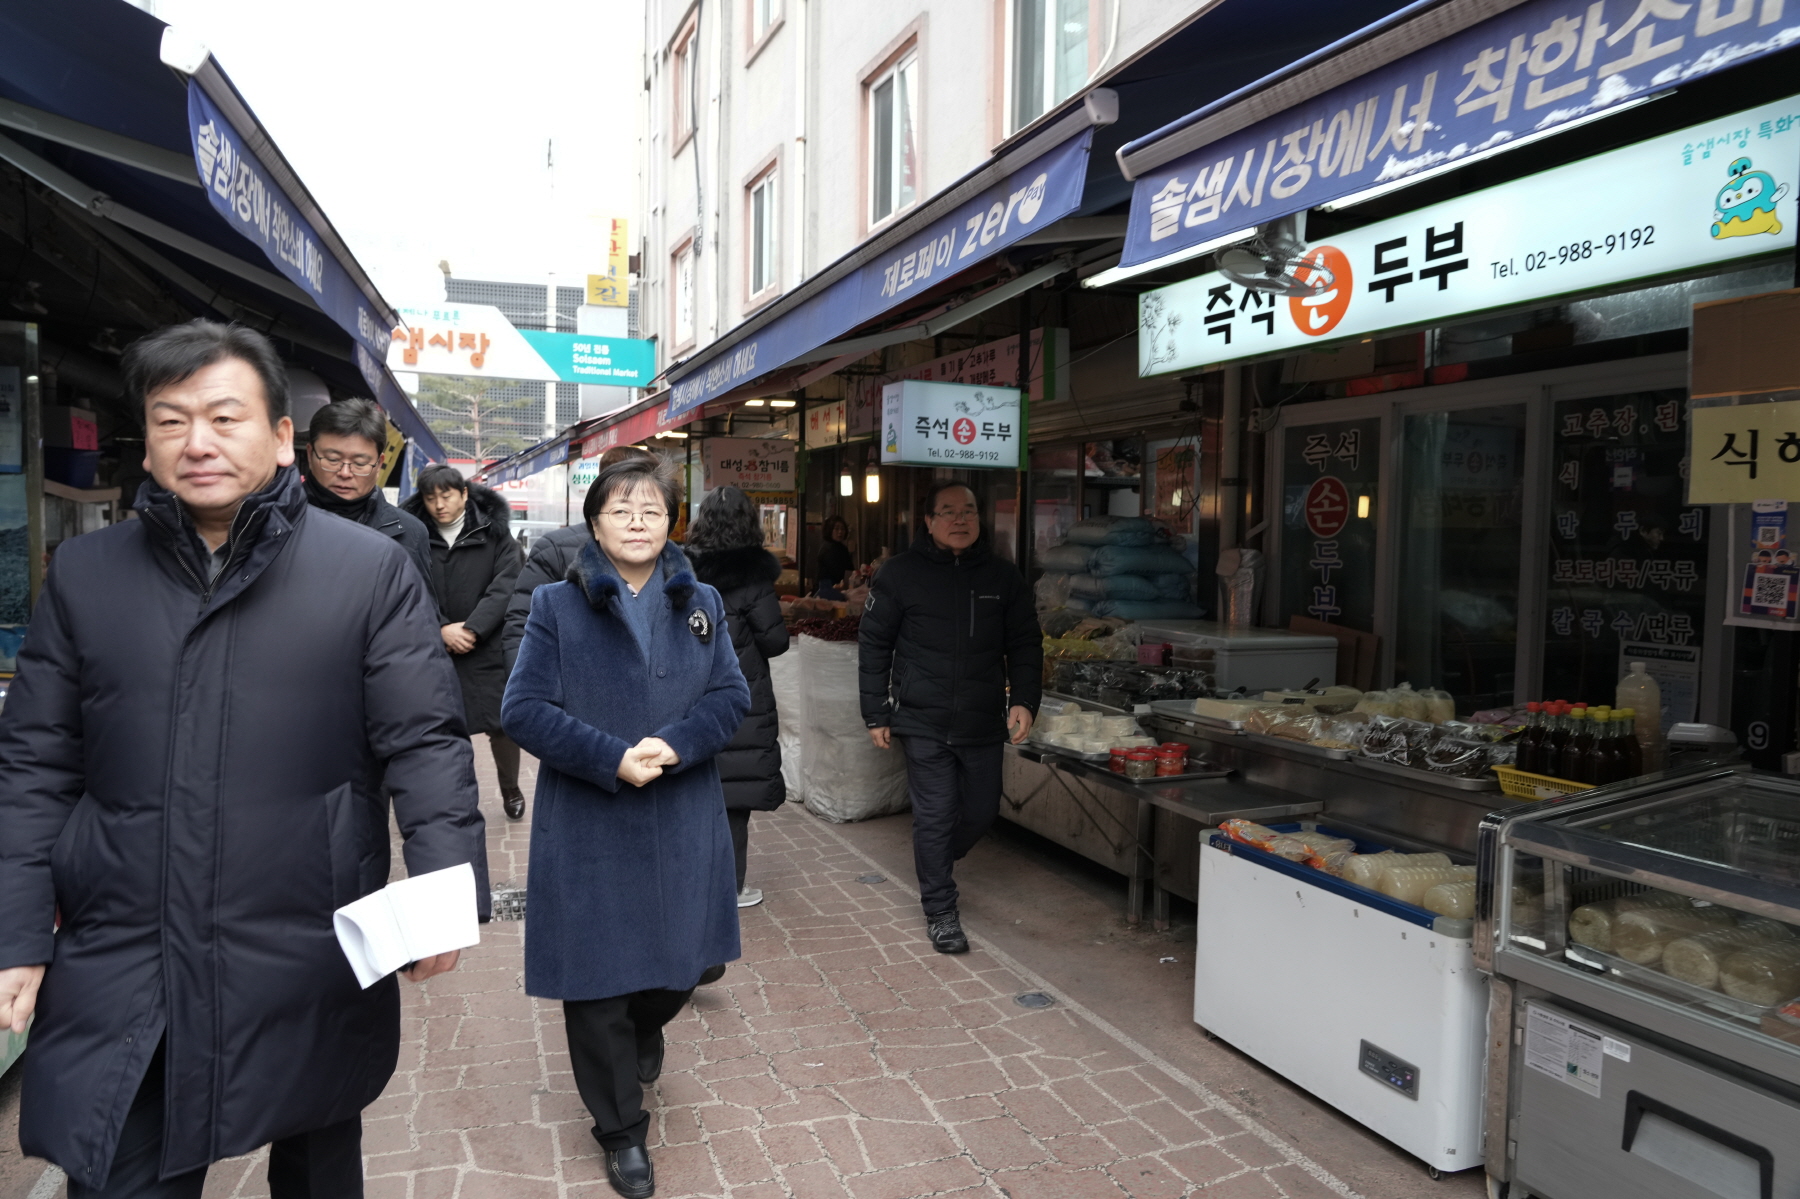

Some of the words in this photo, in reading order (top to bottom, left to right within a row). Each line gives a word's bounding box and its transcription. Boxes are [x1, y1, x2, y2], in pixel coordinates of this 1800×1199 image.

[1149, 70, 1438, 242] 솔샘시장에서
[1681, 127, 1751, 166] 솔샘시장
[197, 119, 271, 244] 솔샘시장에서
[272, 201, 305, 277] 착한소비
[305, 239, 323, 294] 하세요
[880, 227, 957, 298] 제로페이
[1368, 222, 1469, 303] 두부
[1490, 257, 1519, 280] Tel.
[1525, 225, 1656, 272] 02-988-9192
[572, 365, 612, 376] Traditional
[613, 368, 639, 378] Market
[915, 416, 950, 440] 즉석
[956, 418, 972, 444] 손
[980, 422, 1012, 442] 두부
[1303, 429, 1360, 472] 즉석
[720, 458, 743, 472] 대성
[758, 459, 789, 473] 참기름
[927, 448, 942, 458] Tel.
[944, 449, 999, 461] 02-988-9192
[1307, 481, 1345, 529] 손
